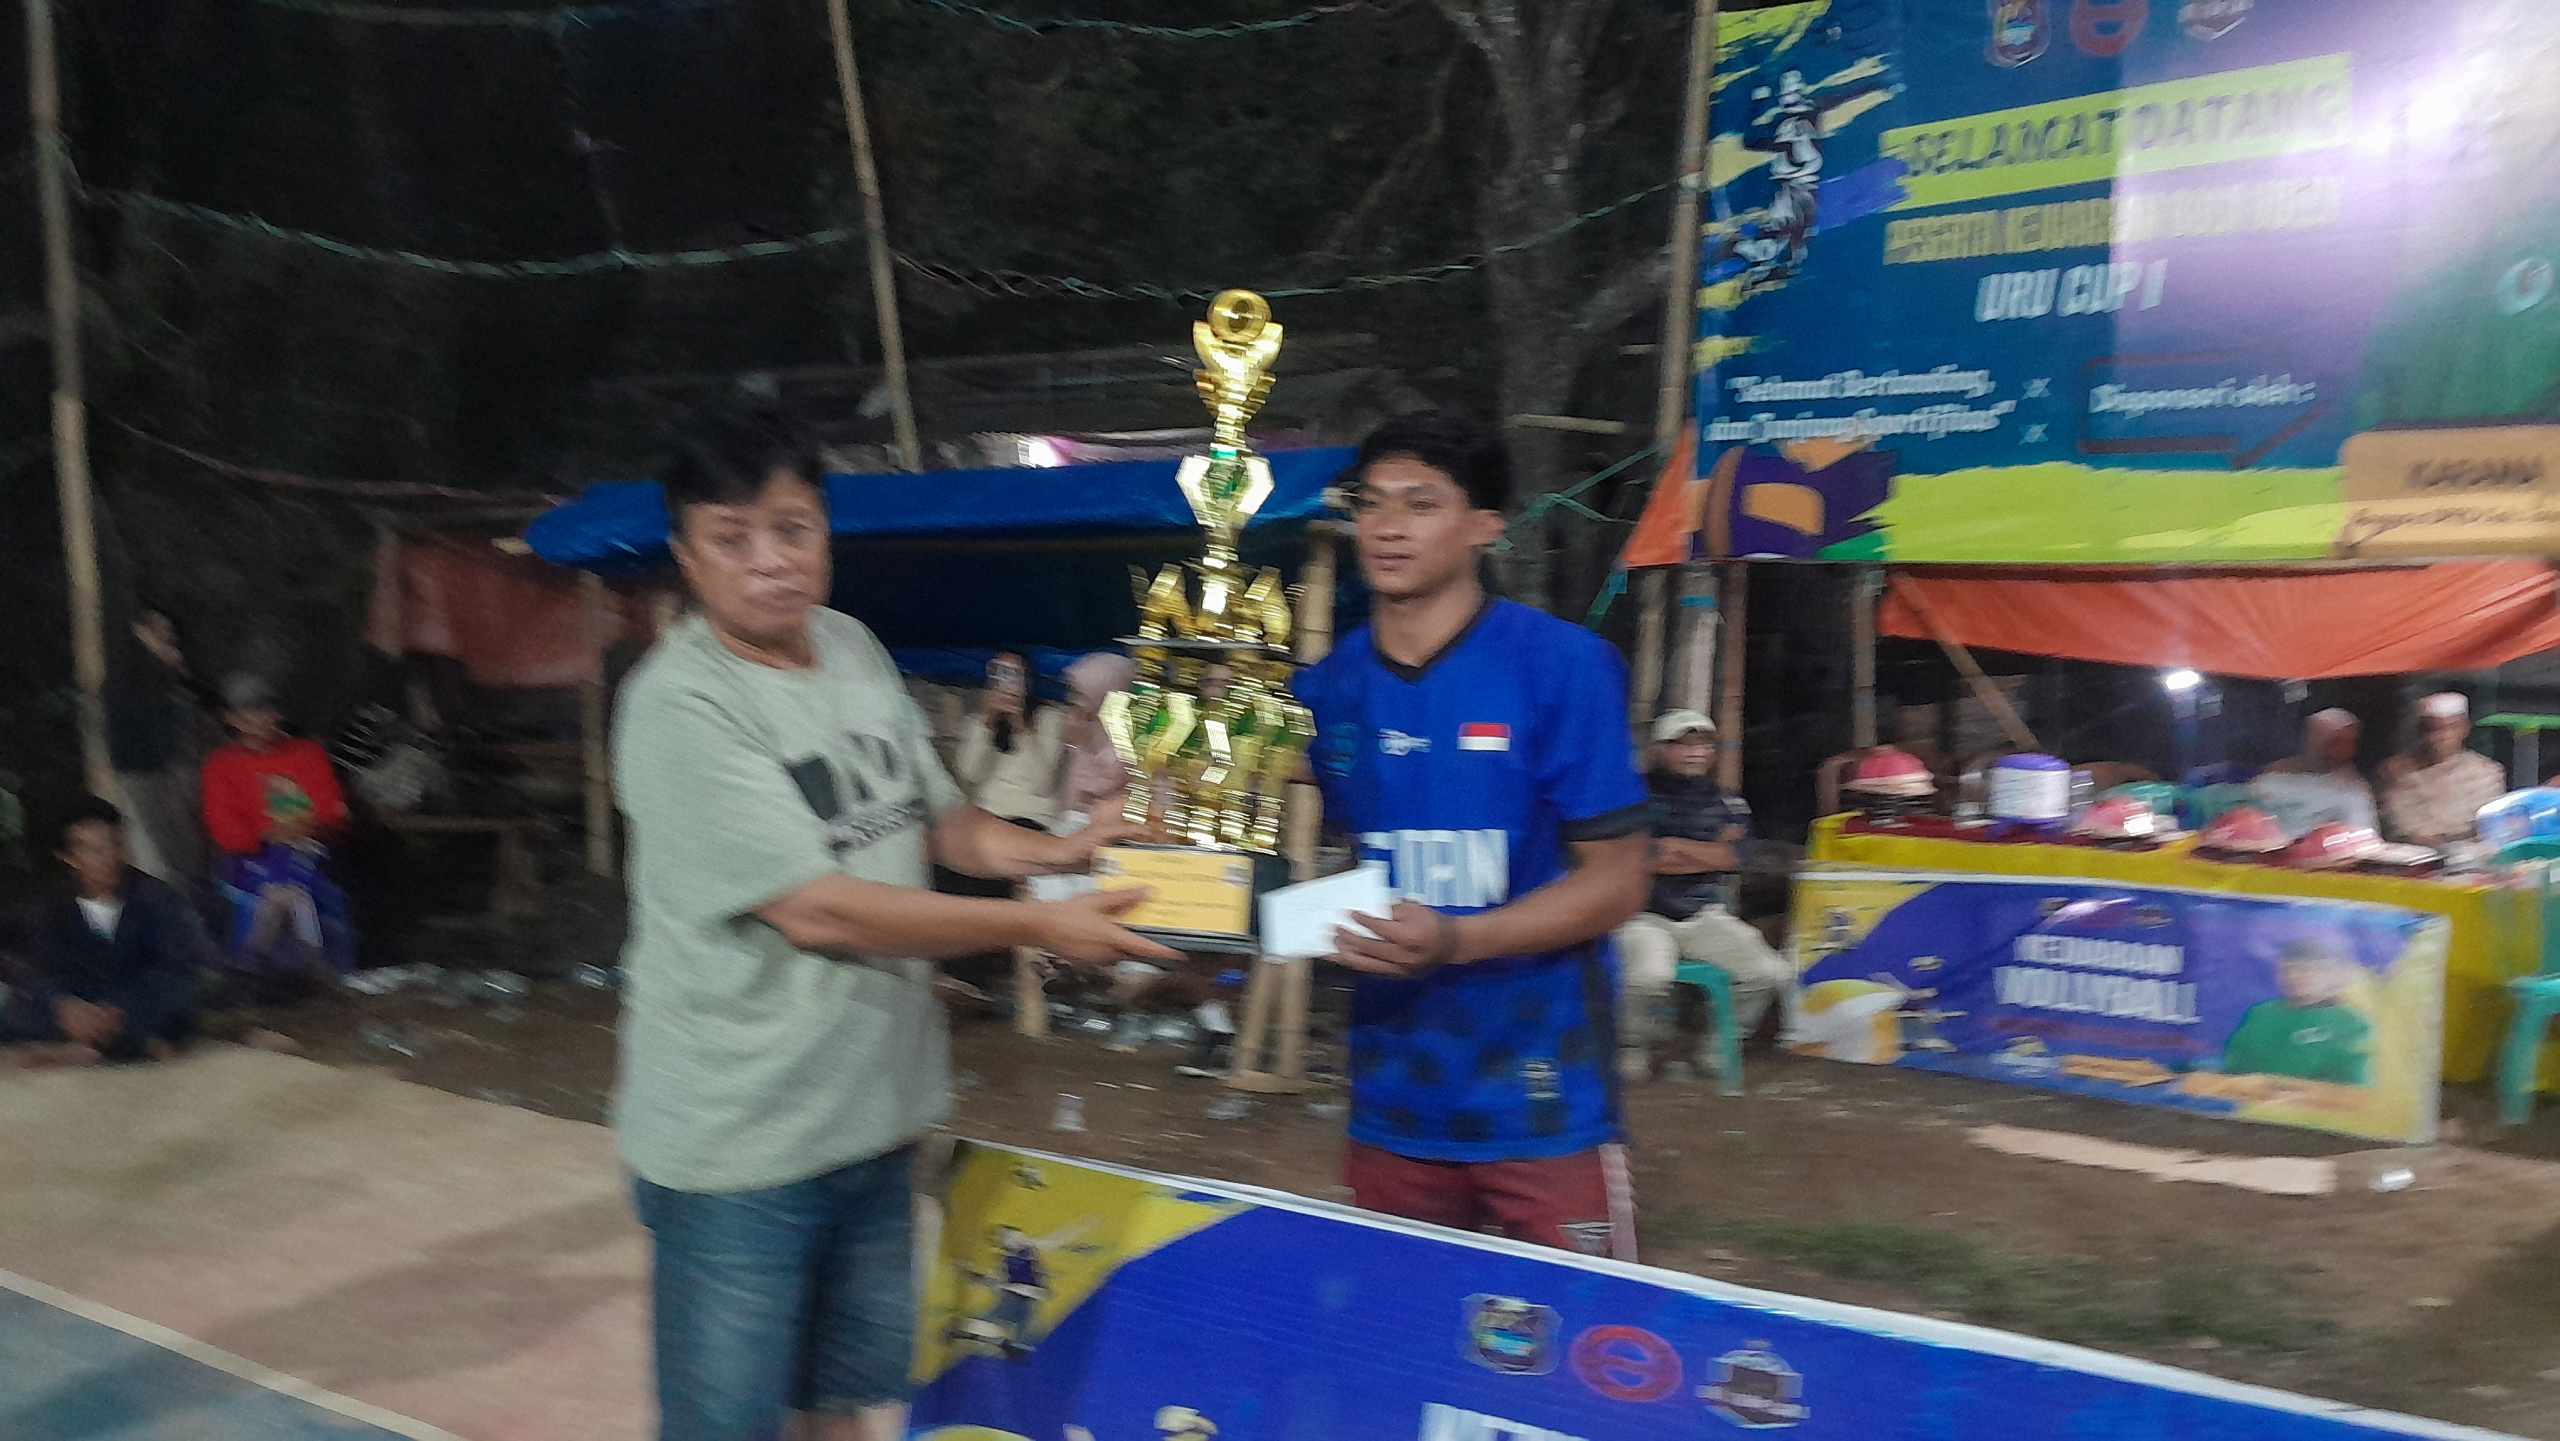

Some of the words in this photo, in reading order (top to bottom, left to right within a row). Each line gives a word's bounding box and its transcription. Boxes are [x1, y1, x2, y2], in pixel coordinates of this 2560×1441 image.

[1902, 107, 2124, 177] SELAMAT
[2130, 82, 2340, 151] DATANG
[1975, 268, 2059, 323] URU
[2057, 261, 2142, 317] CUP
